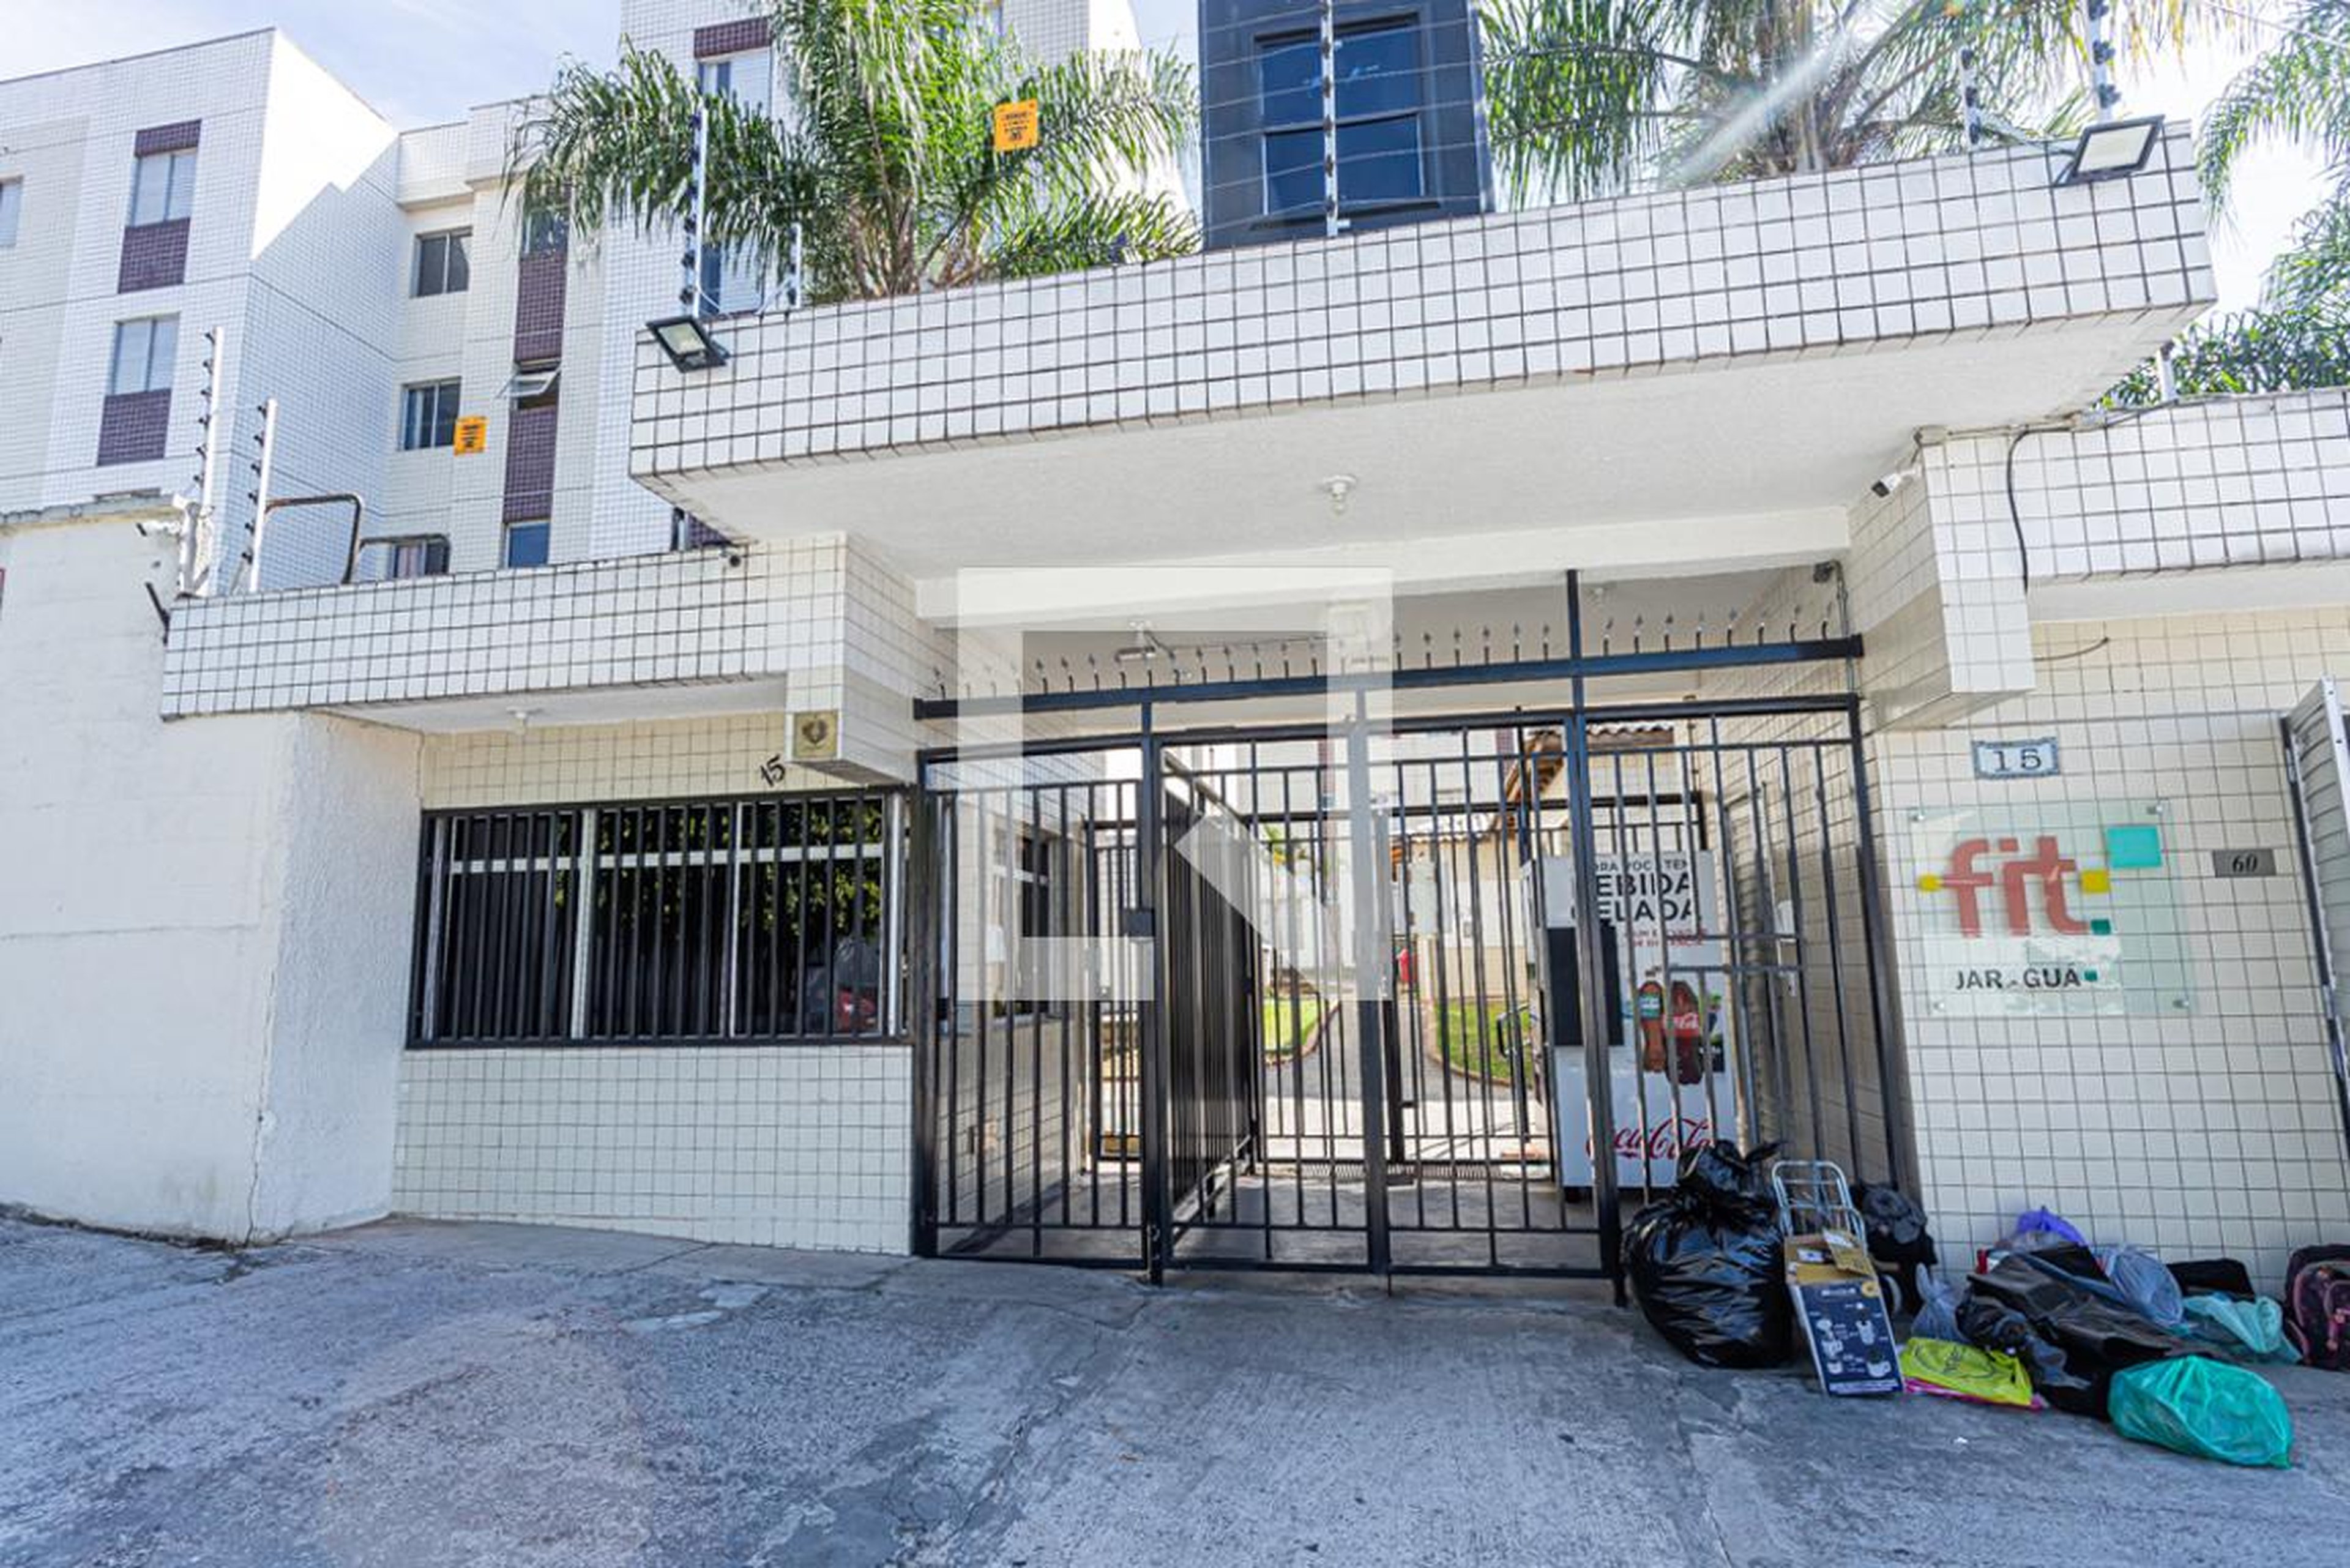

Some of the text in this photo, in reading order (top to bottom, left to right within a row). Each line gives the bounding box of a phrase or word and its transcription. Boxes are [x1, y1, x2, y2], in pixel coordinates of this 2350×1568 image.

[759, 753, 785, 788] 15
[1993, 748, 2048, 772] 15
[2232, 853, 2258, 873] 60
[1595, 872, 1690, 897] EBIDA
[1941, 836, 2089, 938] fit
[1570, 899, 1692, 923] ELADA
